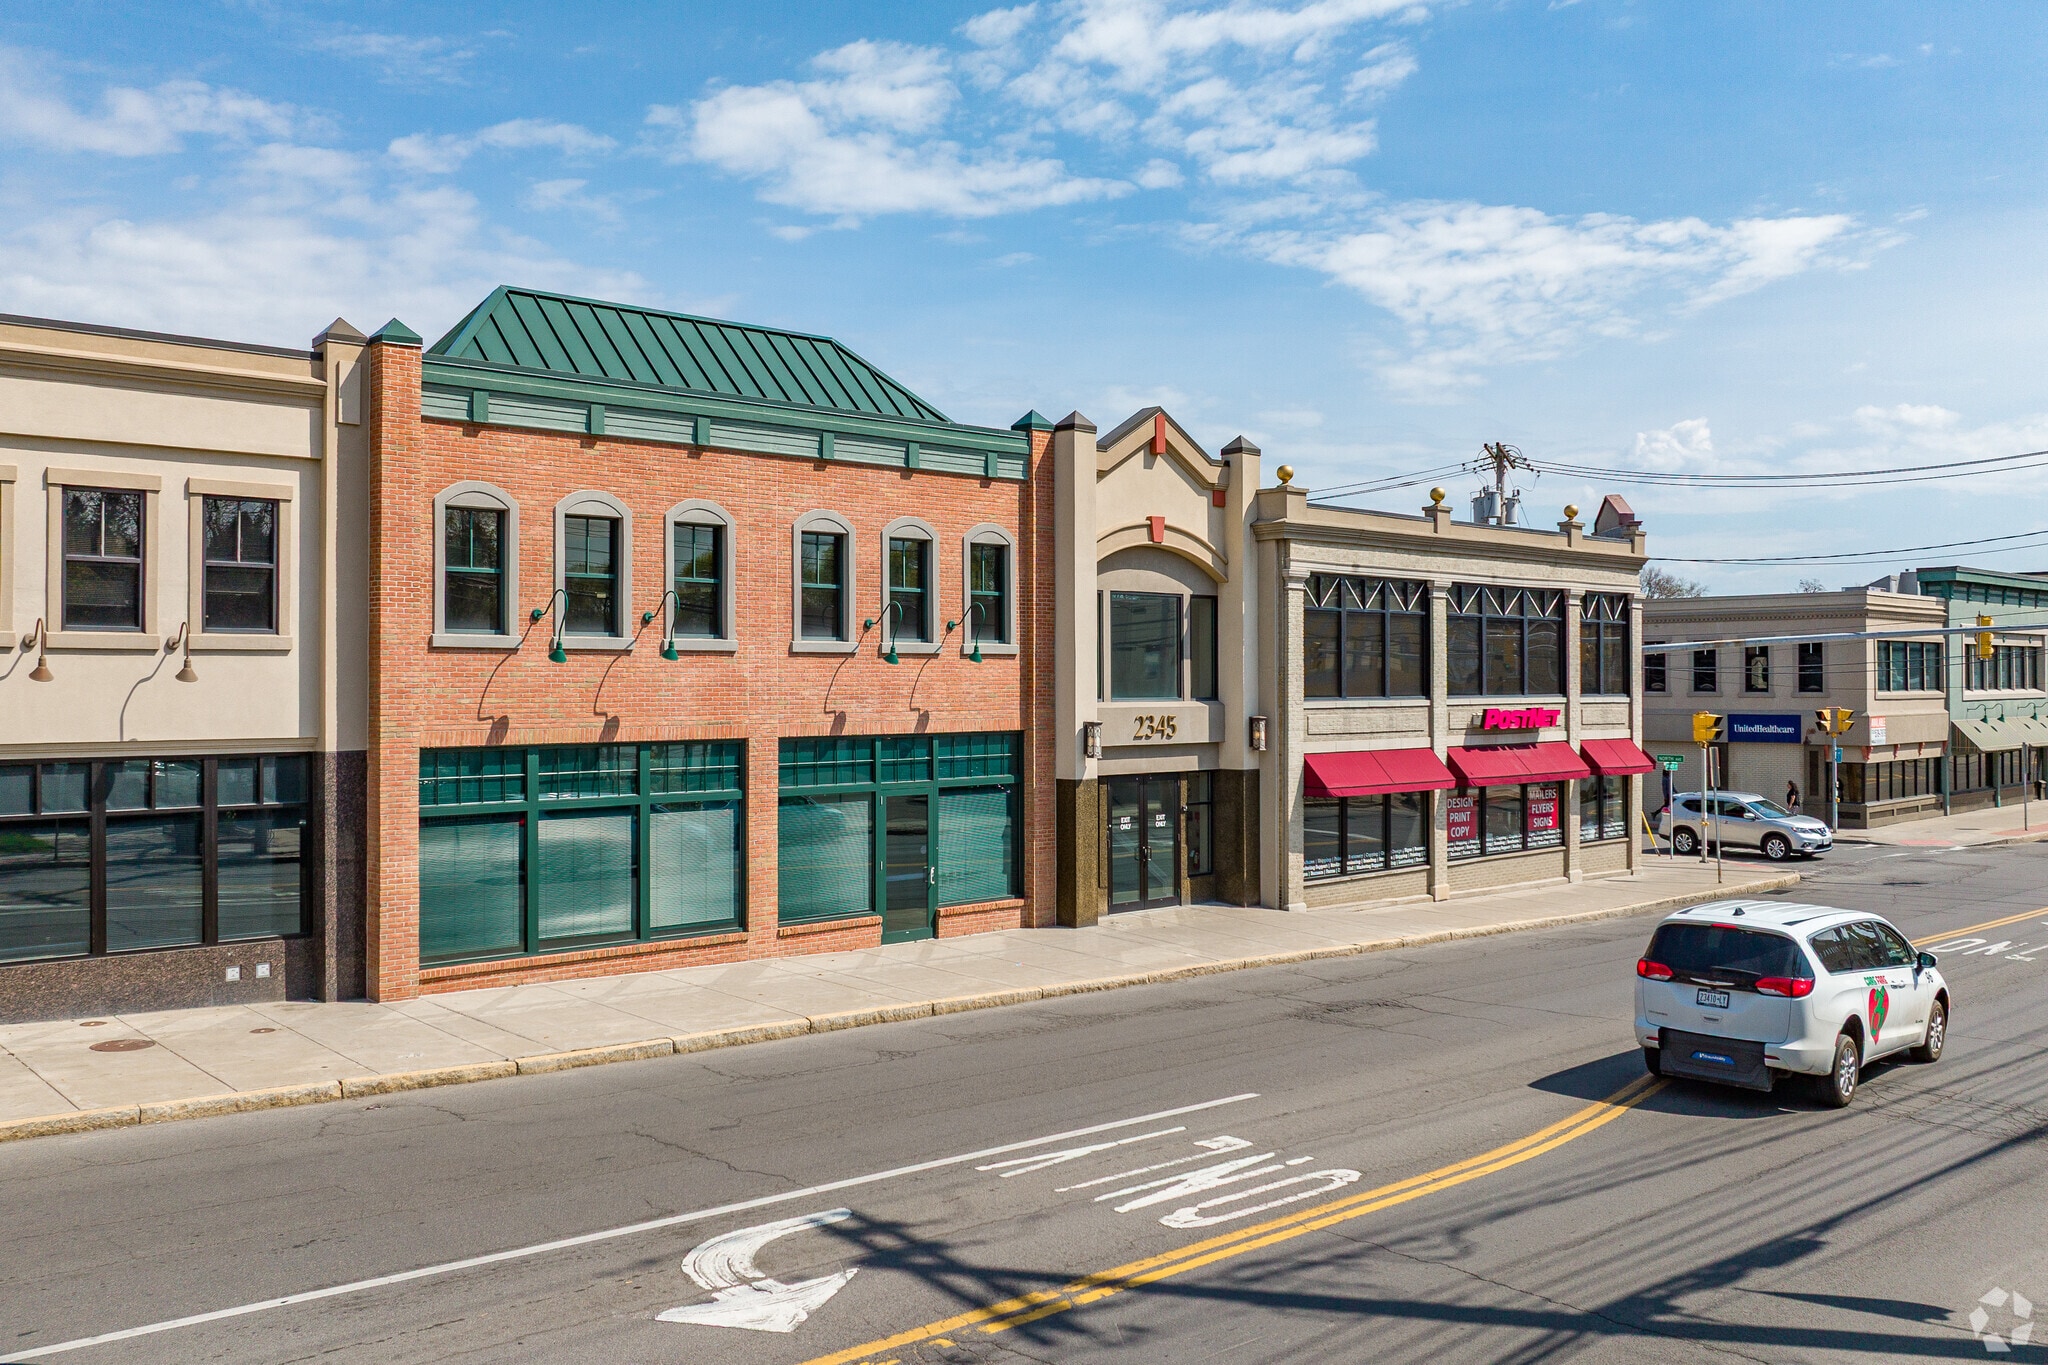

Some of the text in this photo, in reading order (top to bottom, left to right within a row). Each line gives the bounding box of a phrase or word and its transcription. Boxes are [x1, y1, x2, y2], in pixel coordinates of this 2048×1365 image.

[1133, 715, 1177, 740] 2345
[1734, 724, 1795, 734] UnitedHealthcare
[1529, 788, 1557, 800] MAILERS
[1447, 797, 1473, 809] DESIGN
[1531, 803, 1554, 814] FLYERS
[1449, 811, 1471, 823] PRINT
[1533, 816, 1553, 828] SIGNS
[1155, 820, 1166, 828] ONLY
[1450, 826, 1470, 838] COPY
[975, 1126, 1362, 1229] ONLY
